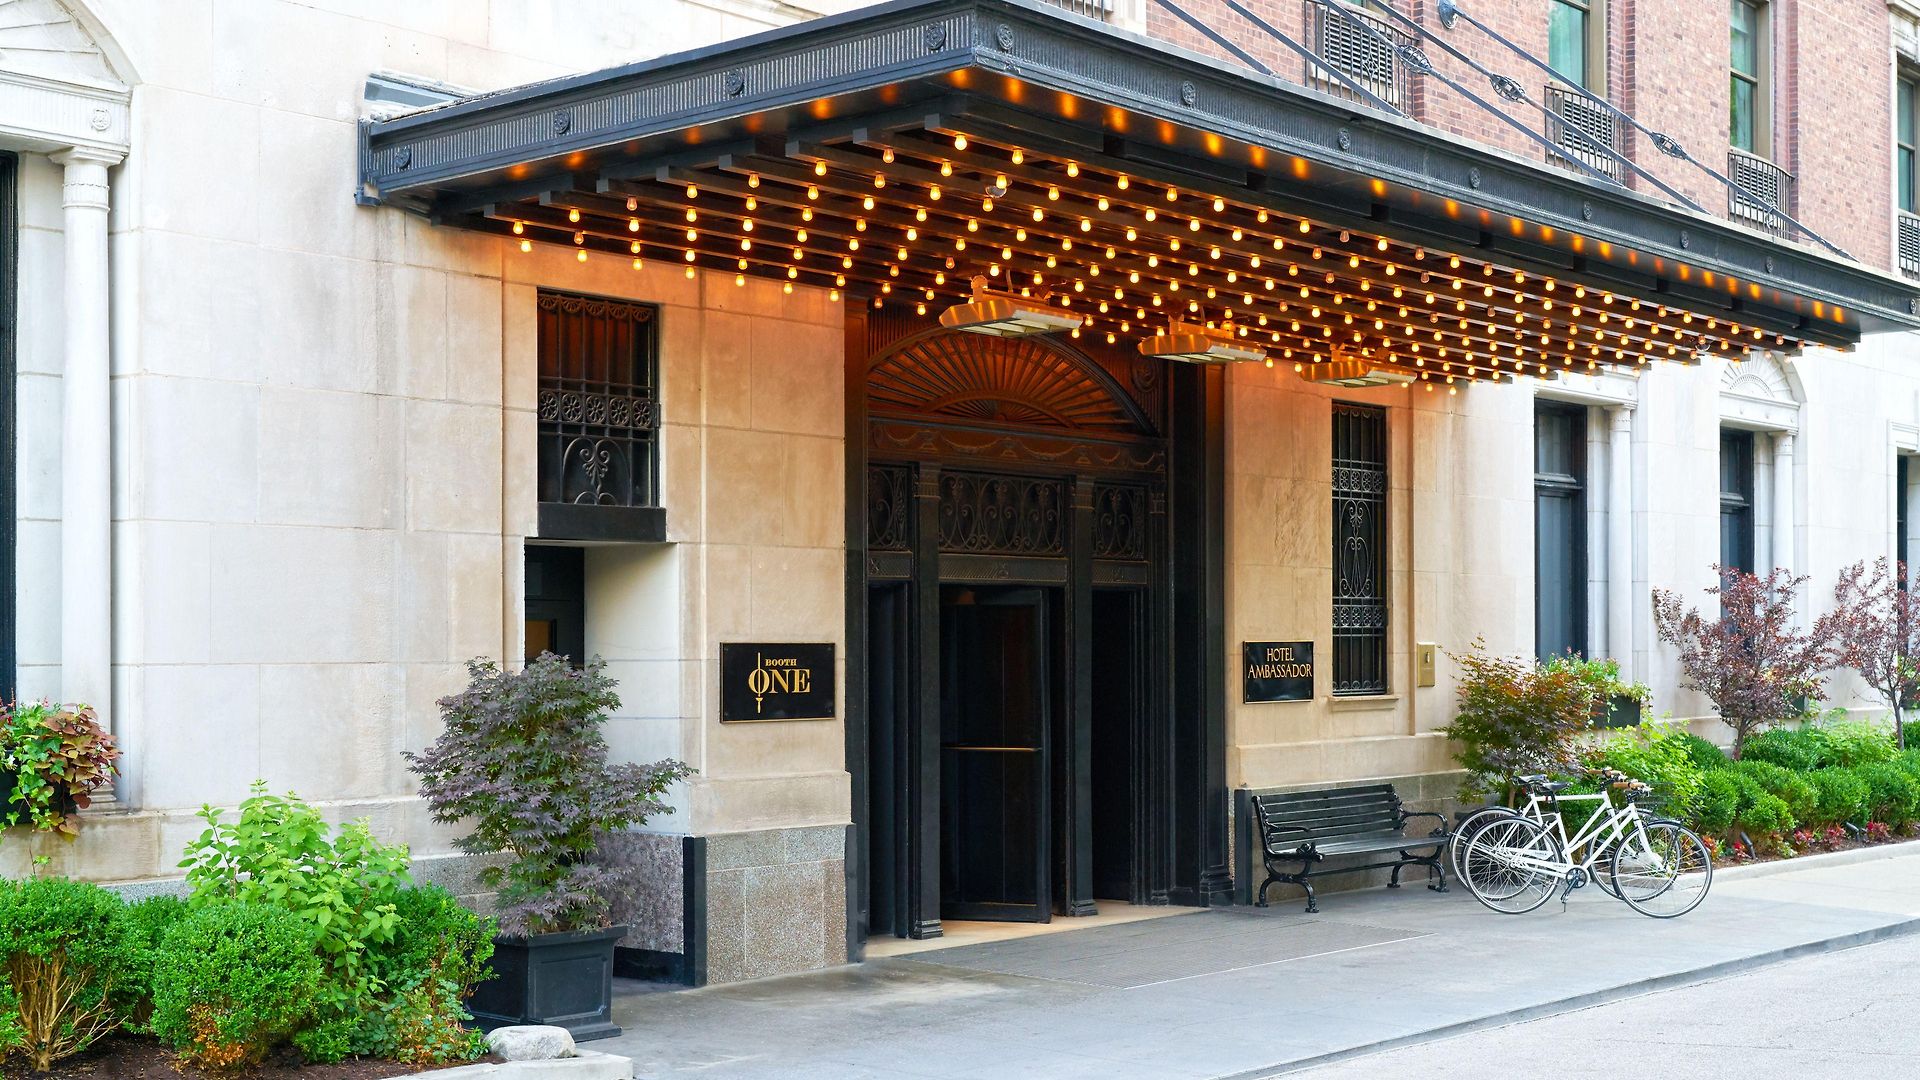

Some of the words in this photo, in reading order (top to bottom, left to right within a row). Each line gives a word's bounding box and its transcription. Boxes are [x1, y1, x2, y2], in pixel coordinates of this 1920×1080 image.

[1266, 647, 1295, 662] HOTEL
[1247, 663, 1312, 679] AMBASSADOR
[748, 668, 810, 694] ONE
